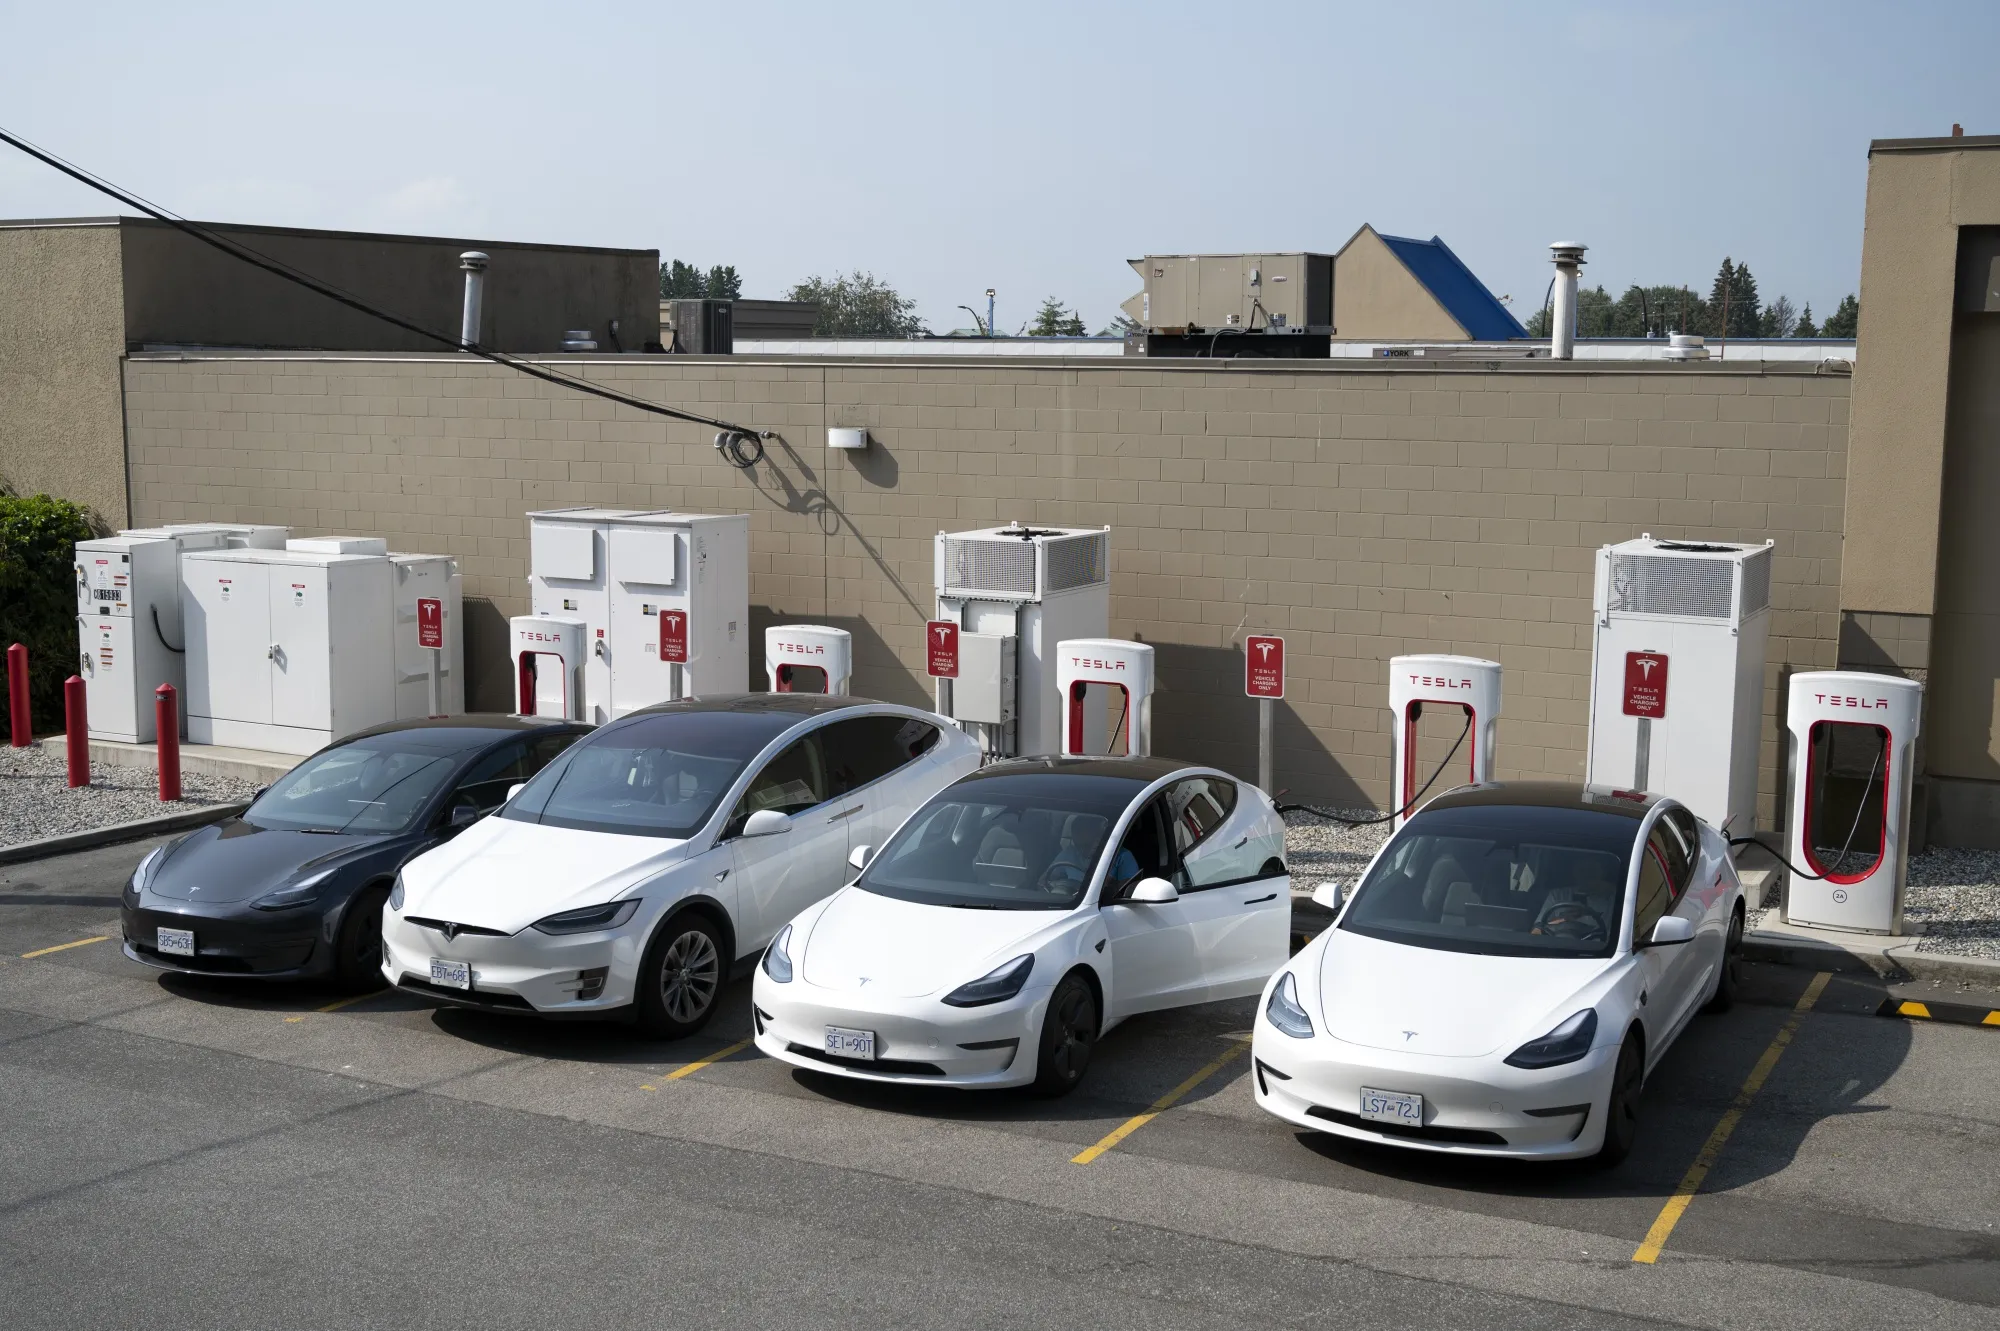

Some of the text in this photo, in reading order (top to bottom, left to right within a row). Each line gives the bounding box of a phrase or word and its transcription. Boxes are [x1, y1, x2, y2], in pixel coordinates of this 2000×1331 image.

[520, 631, 560, 642] TESLA
[778, 642, 824, 654] TESLA
[1072, 657, 1125, 670] TESLA
[1409, 675, 1471, 689] TESLA
[1629, 699, 1659, 707] CHARGING
[1815, 694, 1888, 710] TESLA
